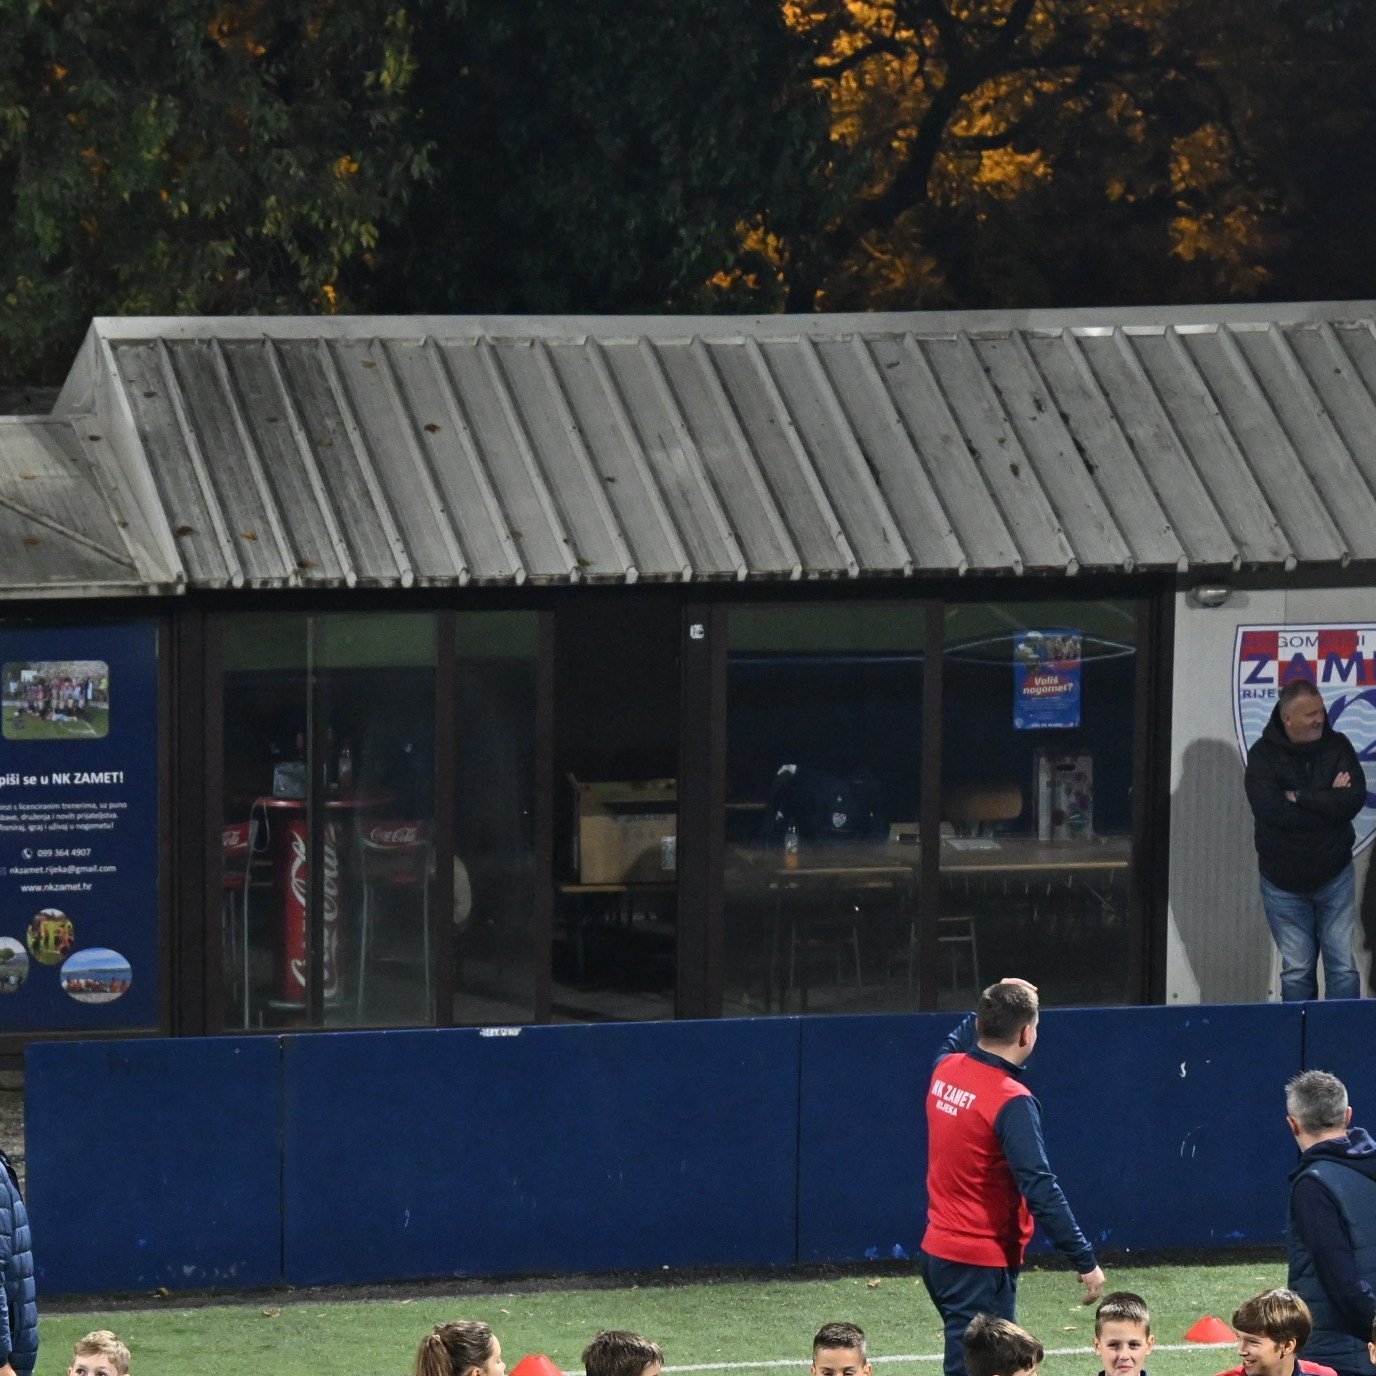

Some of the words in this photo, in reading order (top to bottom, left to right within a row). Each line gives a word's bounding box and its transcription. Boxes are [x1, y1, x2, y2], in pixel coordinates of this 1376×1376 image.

[1243, 687, 1280, 699] RIJE
[23, 777, 37, 785] se
[40, 775, 49, 785] u
[52, 773, 70, 785] NK
[74, 771, 124, 784] ZAMET!
[37, 849, 54, 857] 099
[54, 849, 69, 857] 364
[71, 848, 91, 856] 4907
[943, 1084, 976, 1110] ZAMET
